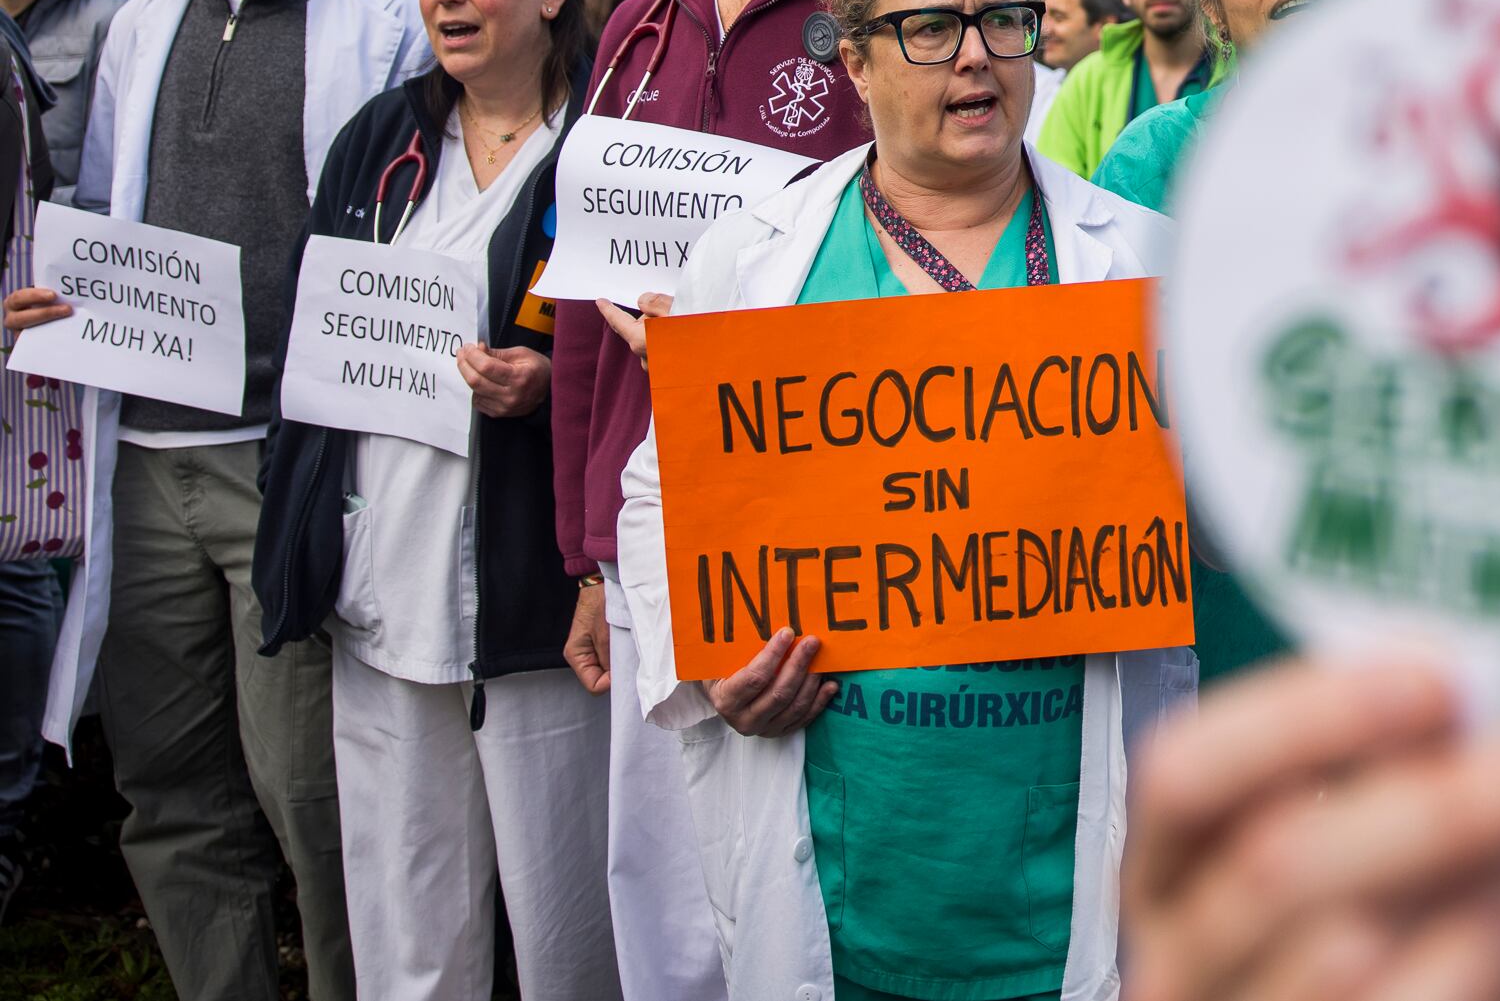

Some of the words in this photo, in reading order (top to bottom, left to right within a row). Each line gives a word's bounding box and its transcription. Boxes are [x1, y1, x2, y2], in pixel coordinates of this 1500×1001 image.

[769, 58, 796, 76] SERVIZO
[797, 57, 808, 65] DE
[602, 142, 753, 175] COMISIÓN
[583, 187, 743, 220] SEGUIMENTO
[72, 237, 201, 285] COMISIÓN
[609, 238, 669, 268] MUH
[60, 275, 217, 326] SEGUIMENTO
[340, 268, 455, 312] COMISIÓN
[81, 318, 144, 351] MUH
[151, 330, 193, 362] XA!
[321, 311, 463, 358] SEGUIMENTO
[342, 360, 403, 391] MUH
[408, 368, 436, 400] XA!
[717, 349, 1170, 455] NEGOCIACION
[882, 467, 970, 513] SIN
[697, 516, 1189, 644] INTERMEDIACIÓN
[880, 684, 1084, 728] CIRÚRXICA
